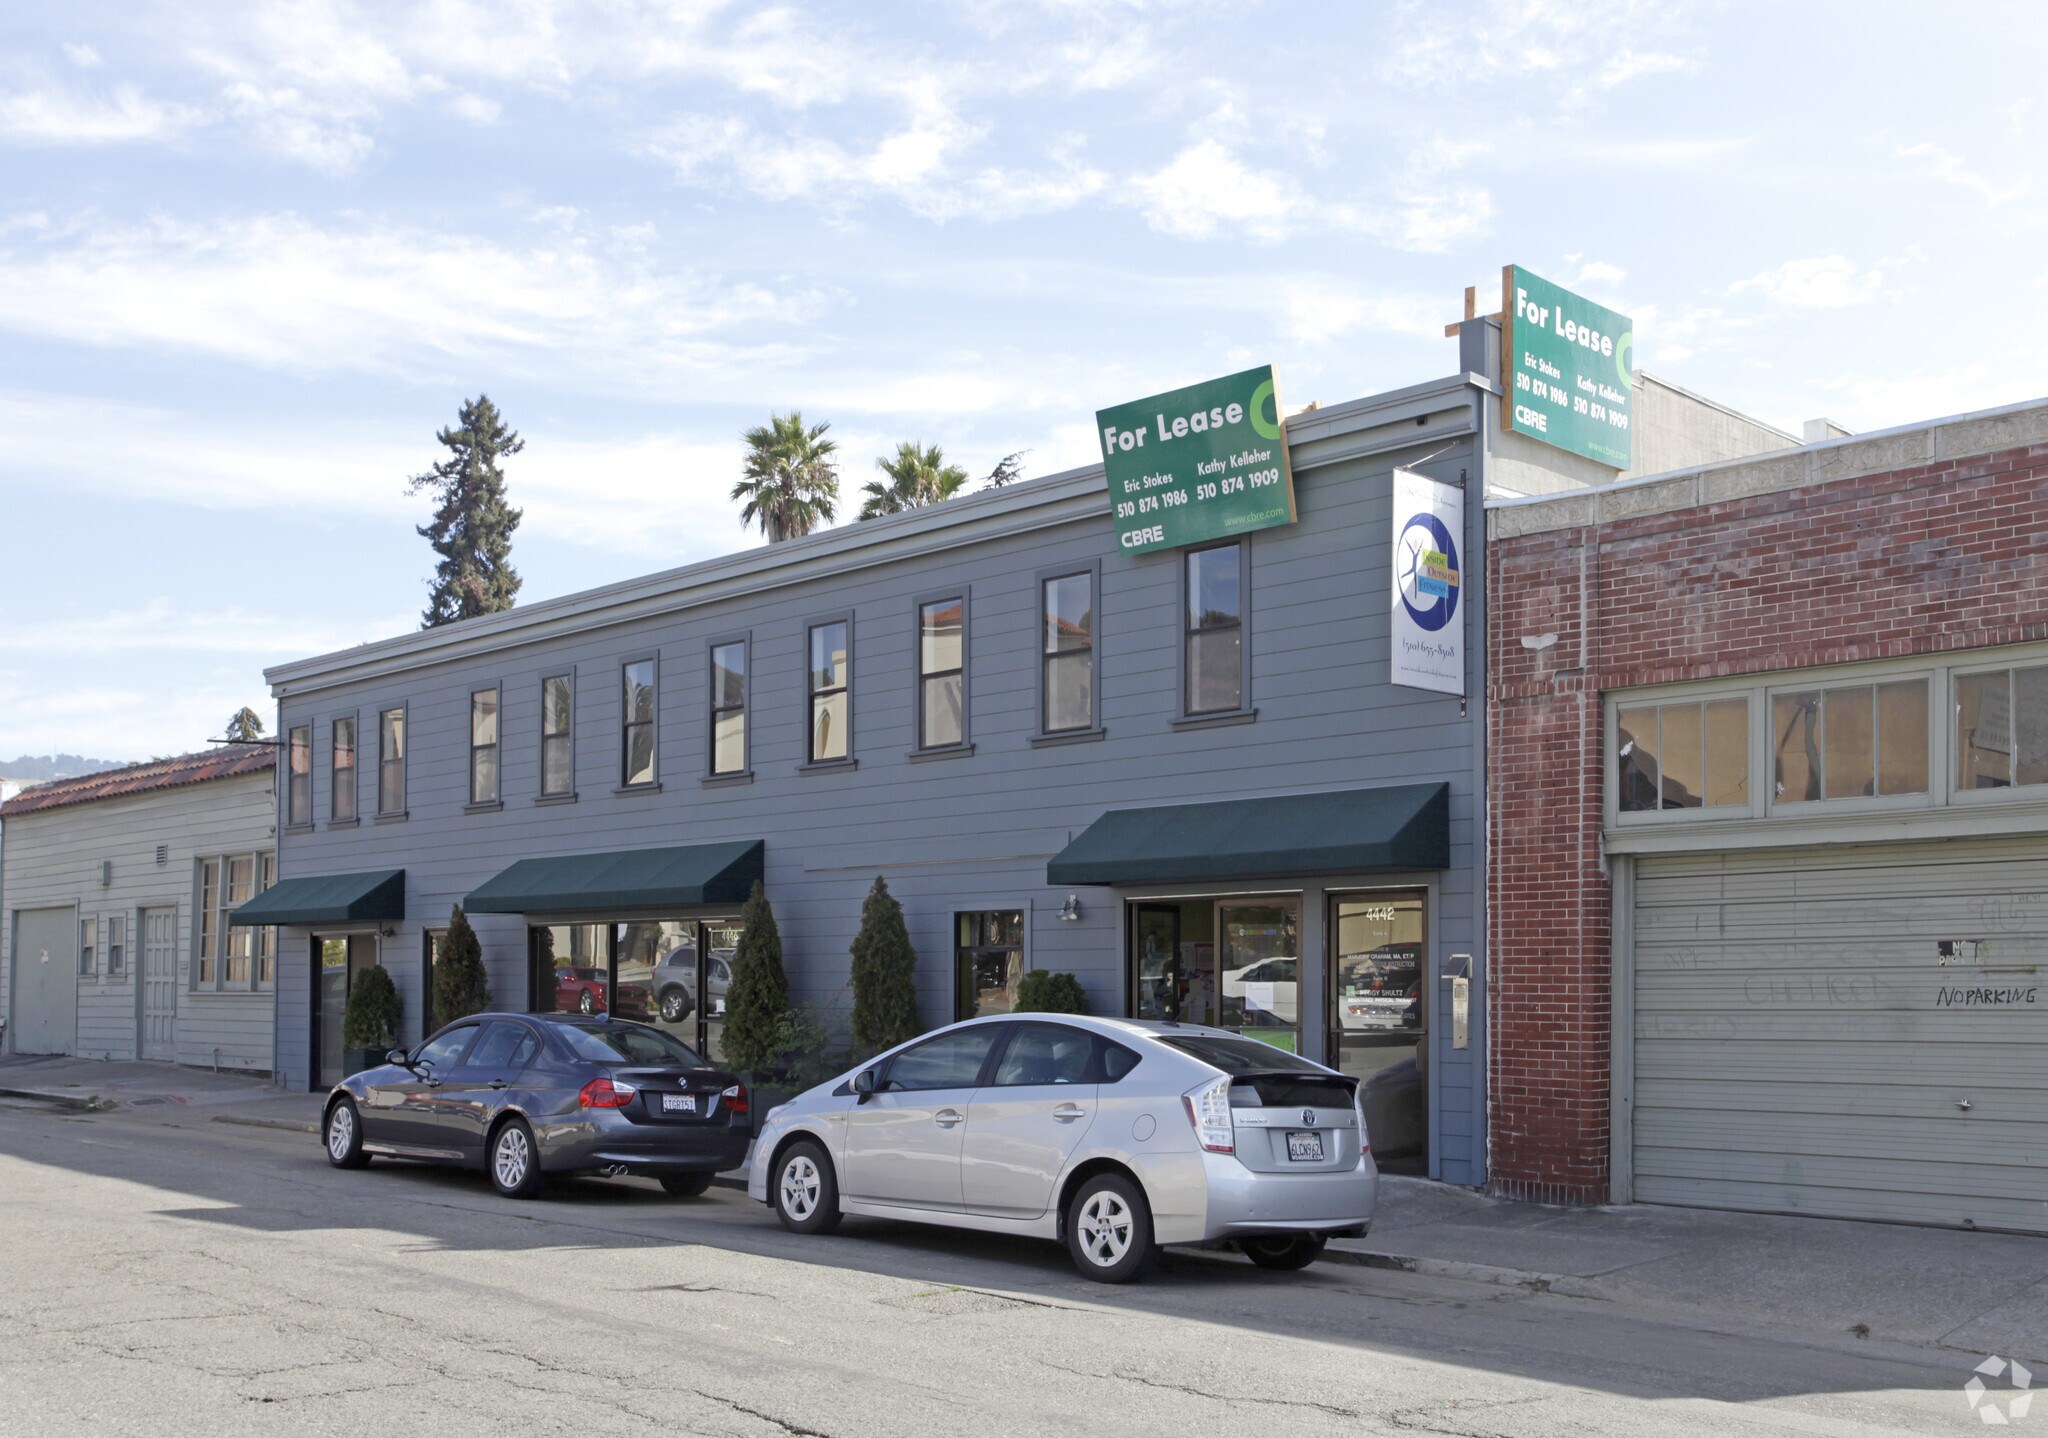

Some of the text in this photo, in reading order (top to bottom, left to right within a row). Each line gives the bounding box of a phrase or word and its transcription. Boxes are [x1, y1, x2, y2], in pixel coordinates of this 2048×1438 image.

[1516, 287, 1613, 357] For Lease
[1525, 351, 1561, 380] Eric Stokes
[1516, 371, 1568, 408] 510 874 1986
[1577, 374, 1626, 406] Kathy Kelleher
[1515, 404, 1547, 433] CBRE
[1573, 396, 1628, 430] 510 874 1909
[1103, 402, 1243, 455] For Lease
[1197, 448, 1272, 477] Kathy Kelleher
[1124, 472, 1174, 493] Eric Stokes
[1196, 467, 1279, 501] 510 874 1909
[1117, 489, 1188, 519] 510 874 1986
[1223, 507, 1284, 528] www.cbre.com
[1120, 525, 1165, 548] CBRE
[1419, 578, 1447, 595] FITNESS
[1427, 565, 1458, 583] OUTSIDE
[1402, 636, 1420, 654] (510)
[1366, 906, 1395, 921] 4442
